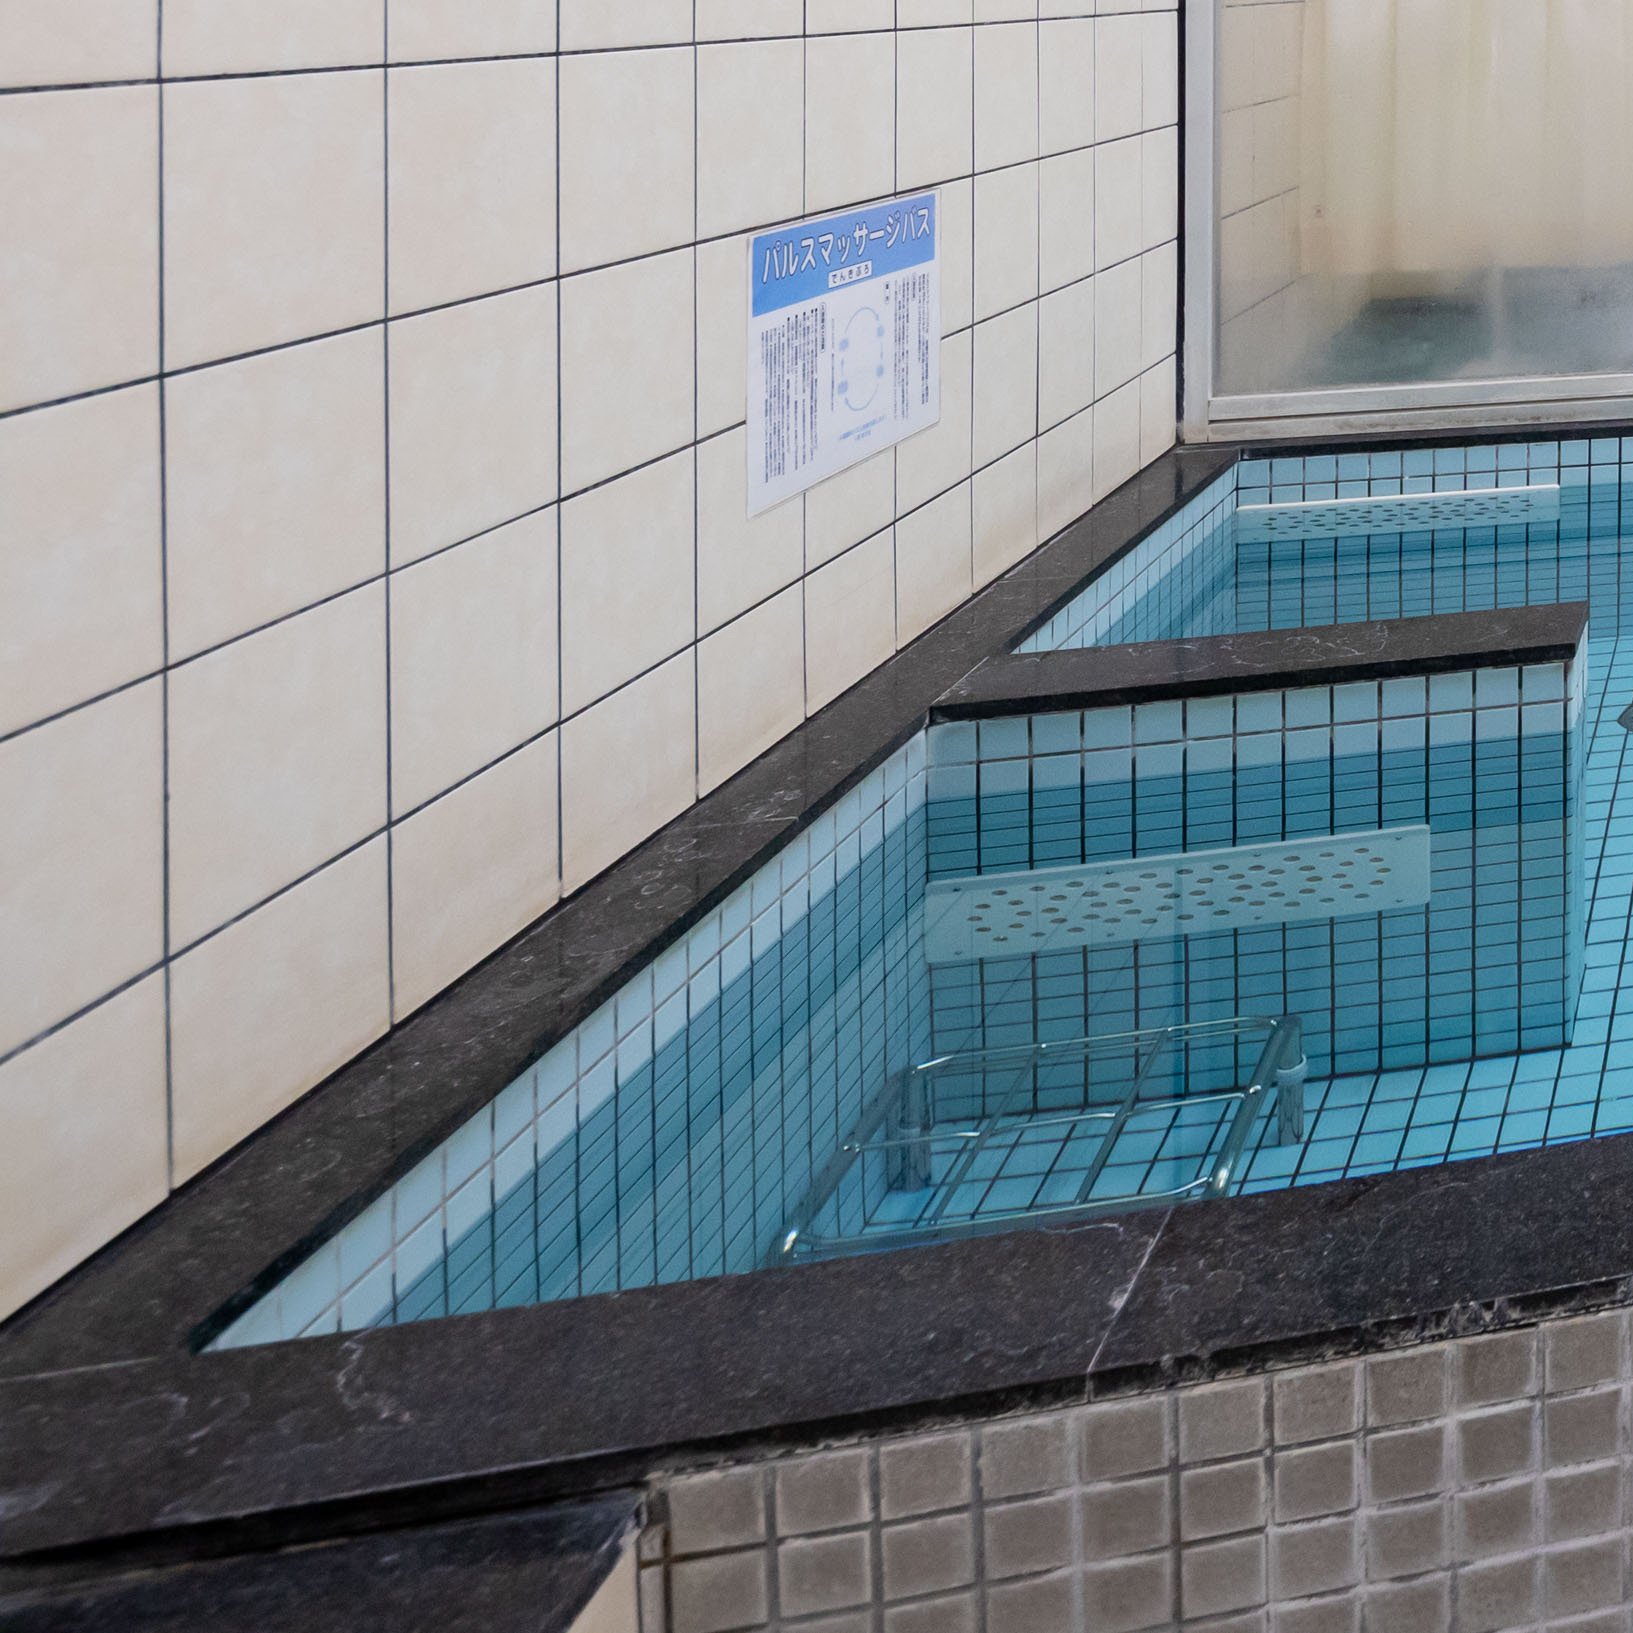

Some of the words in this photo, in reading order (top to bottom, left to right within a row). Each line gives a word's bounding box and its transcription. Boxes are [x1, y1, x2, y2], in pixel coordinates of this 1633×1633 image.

[762, 205, 930, 284] パルスマッサージバス
[831, 264, 872, 285] でんきぶろ
